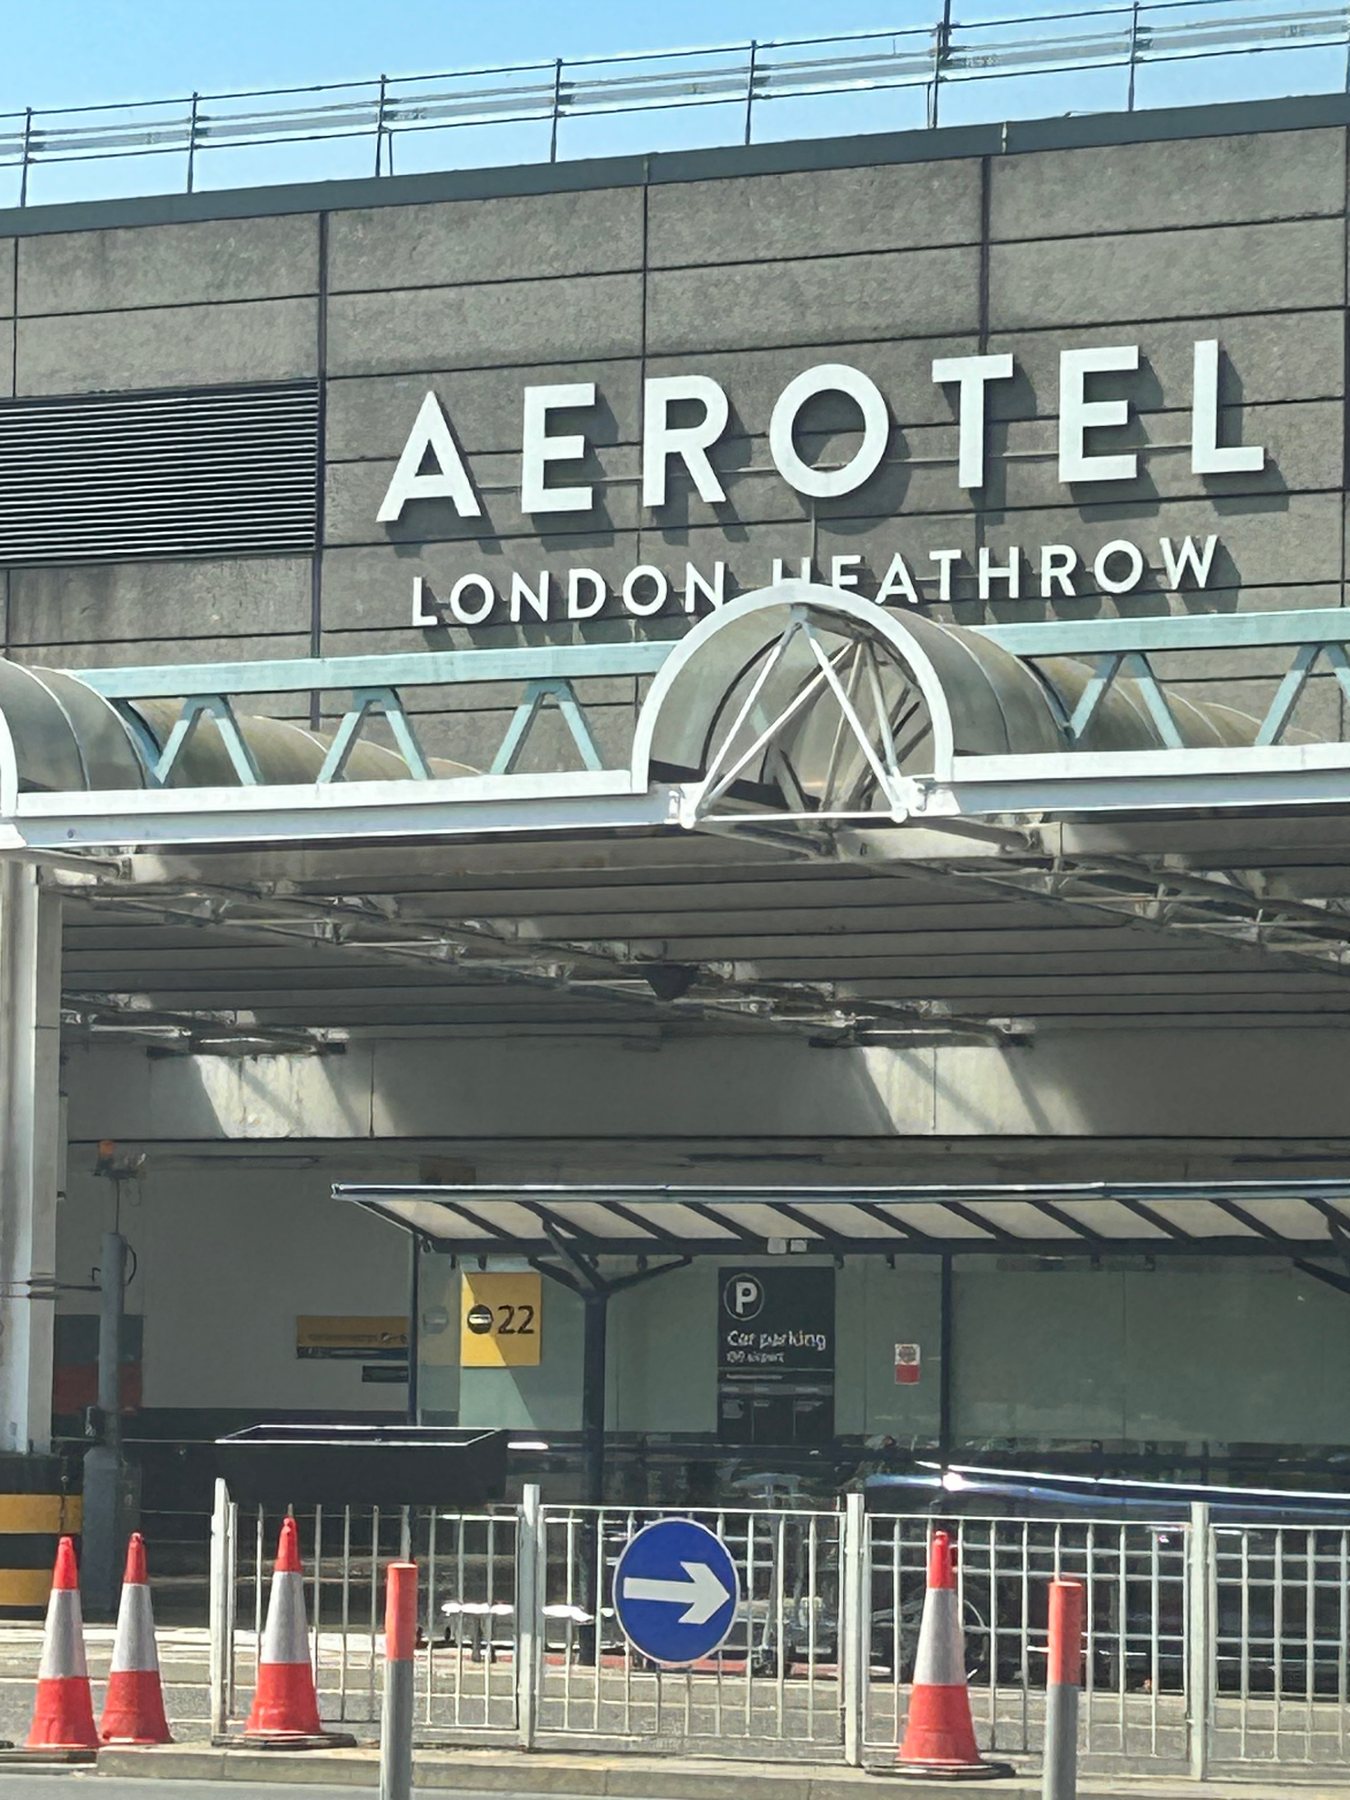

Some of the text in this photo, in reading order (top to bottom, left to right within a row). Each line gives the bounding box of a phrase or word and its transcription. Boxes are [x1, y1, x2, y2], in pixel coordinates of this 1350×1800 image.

[375, 338, 1265, 524] AEROTEL
[411, 560, 726, 628] LONDON
[735, 1281, 758, 1314] P
[497, 1304, 535, 1335] 22
[759, 1329, 827, 1352] parking
